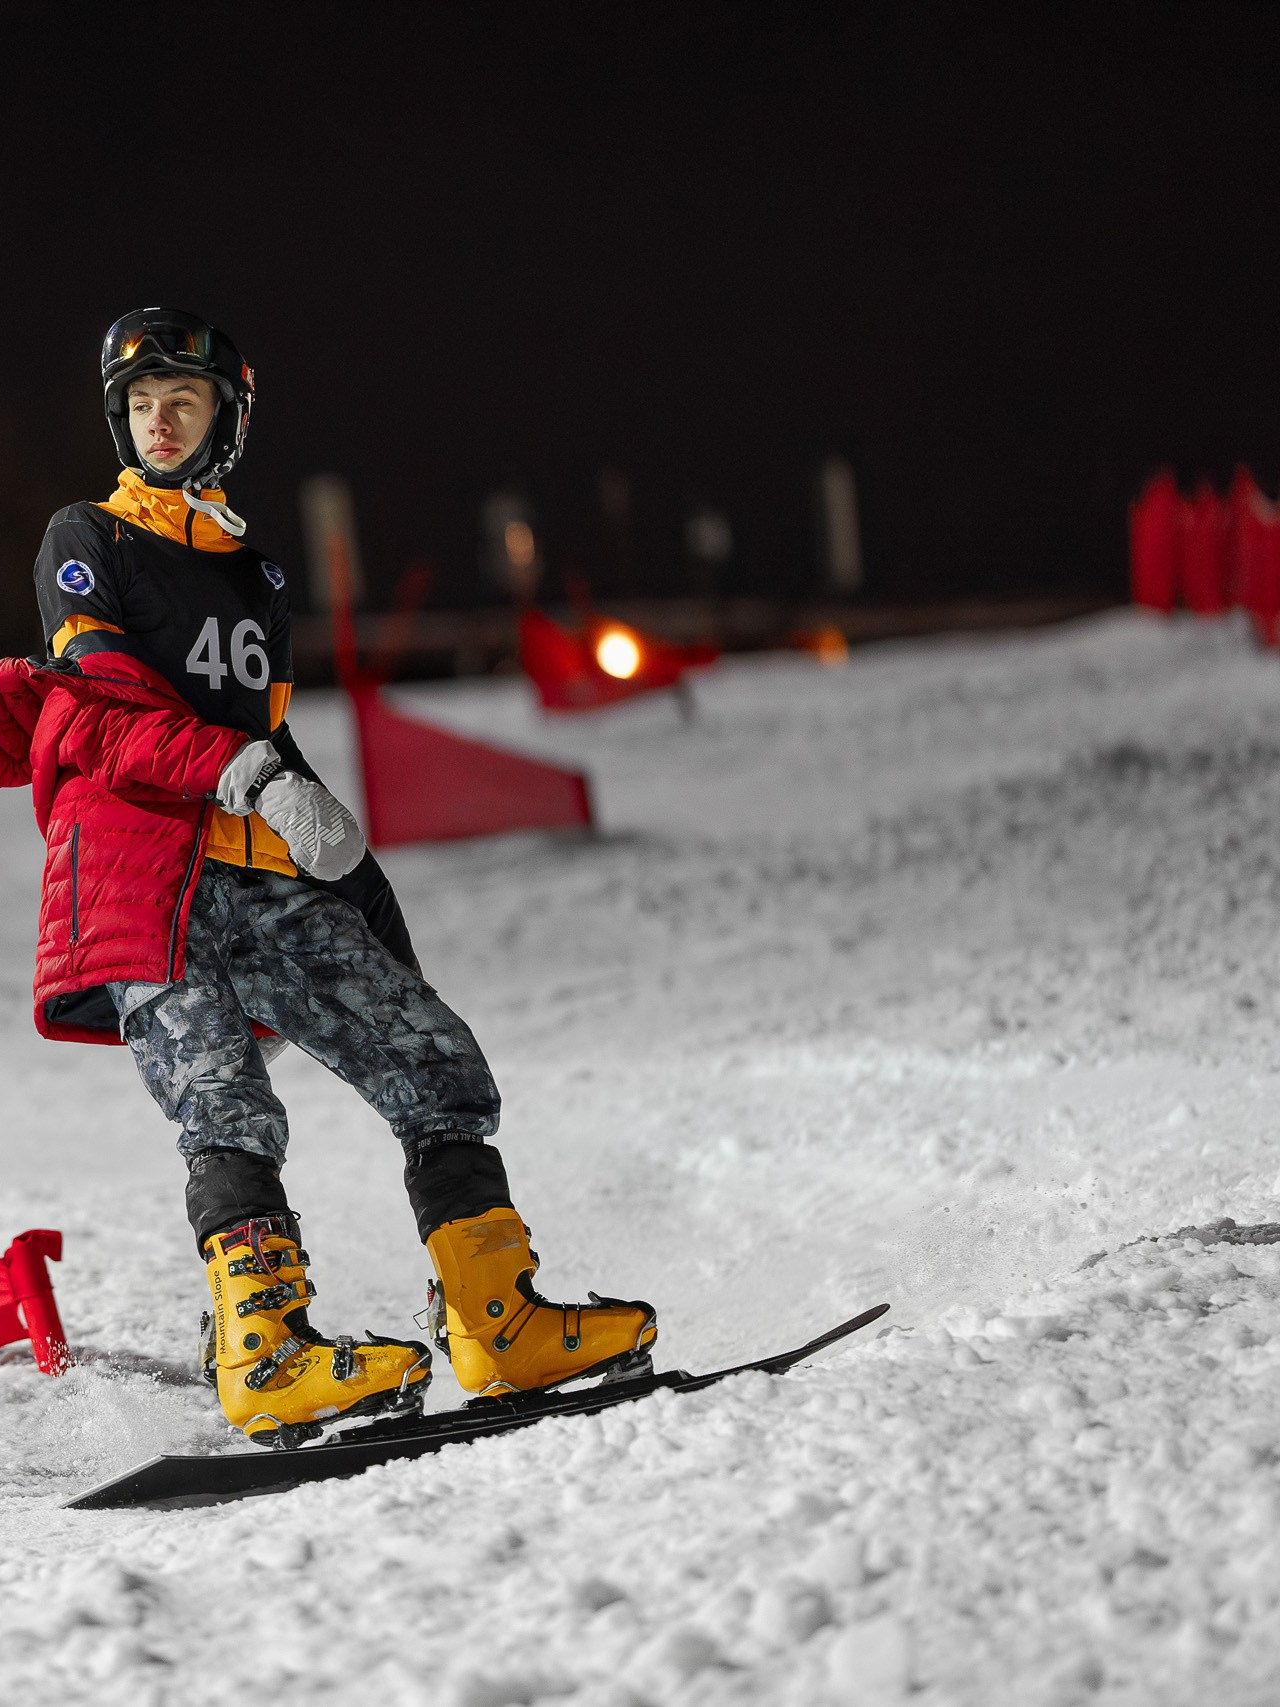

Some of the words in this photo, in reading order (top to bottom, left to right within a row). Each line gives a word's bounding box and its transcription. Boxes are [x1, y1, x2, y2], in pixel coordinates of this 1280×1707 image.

[185, 616, 270, 690] 46
[417, 1137, 432, 1149] RIDE
[442, 1132, 459, 1142] RIDE
[460, 1133, 470, 1141] ALL
[214, 1270, 223, 1301] Slope
[217, 1304, 226, 1354] Mountain
